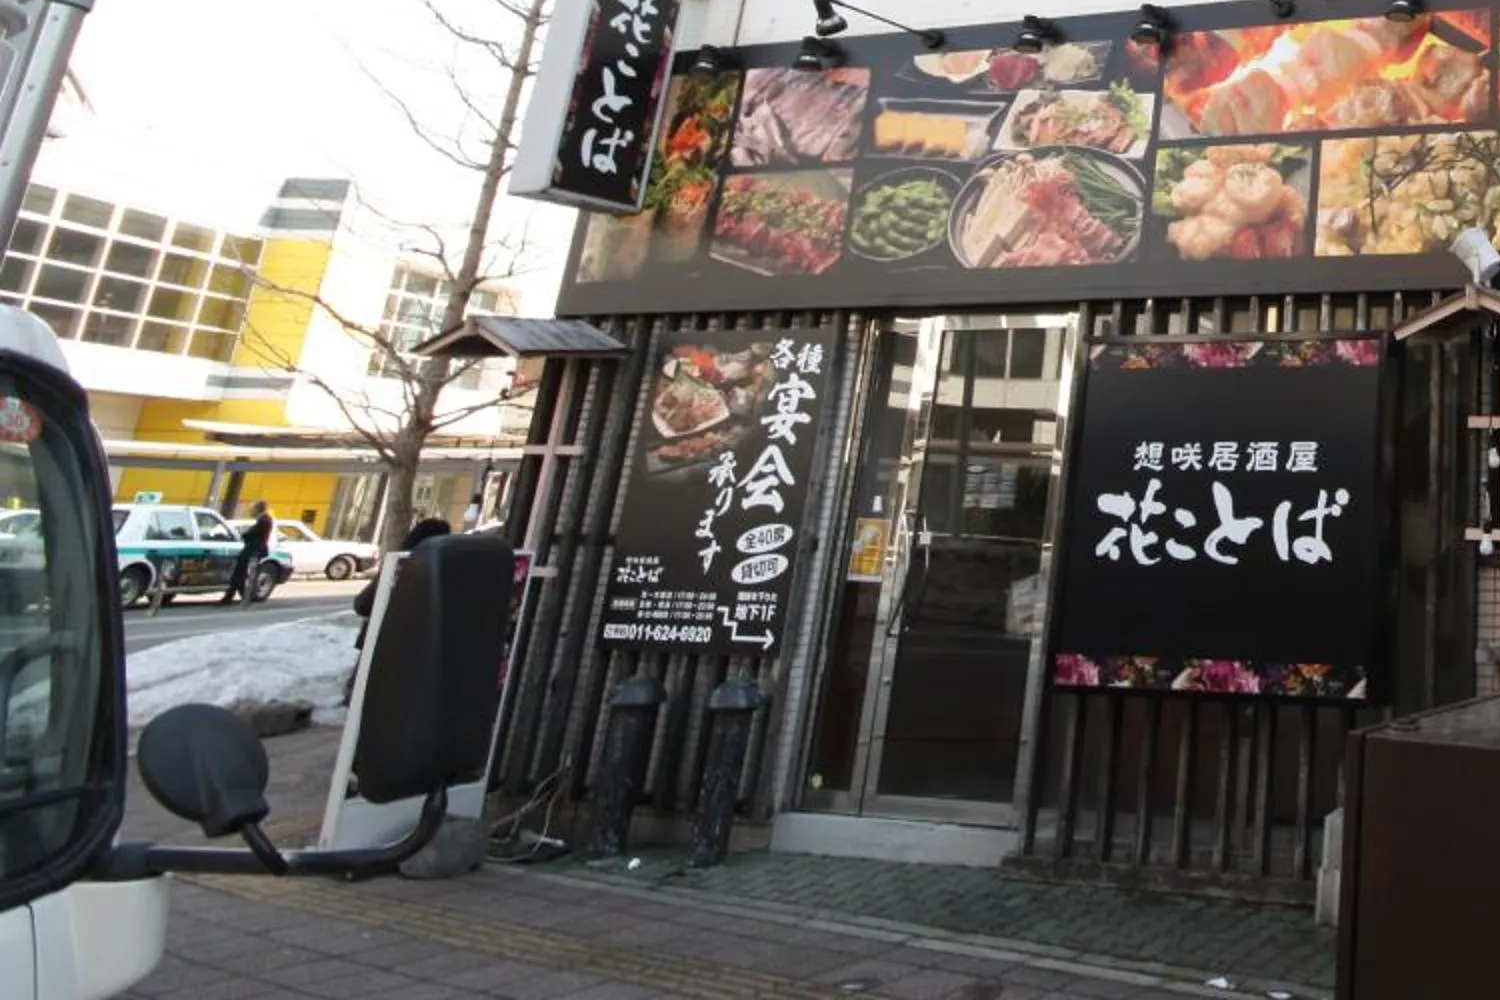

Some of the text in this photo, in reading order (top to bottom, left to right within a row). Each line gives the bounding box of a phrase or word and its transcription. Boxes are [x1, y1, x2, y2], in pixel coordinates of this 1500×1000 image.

[767, 337, 825, 375] 各種
[737, 372, 817, 514] 宴会
[1132, 440, 1320, 474] 想咲居酒屋
[1095, 477, 1351, 567] 花ことば
